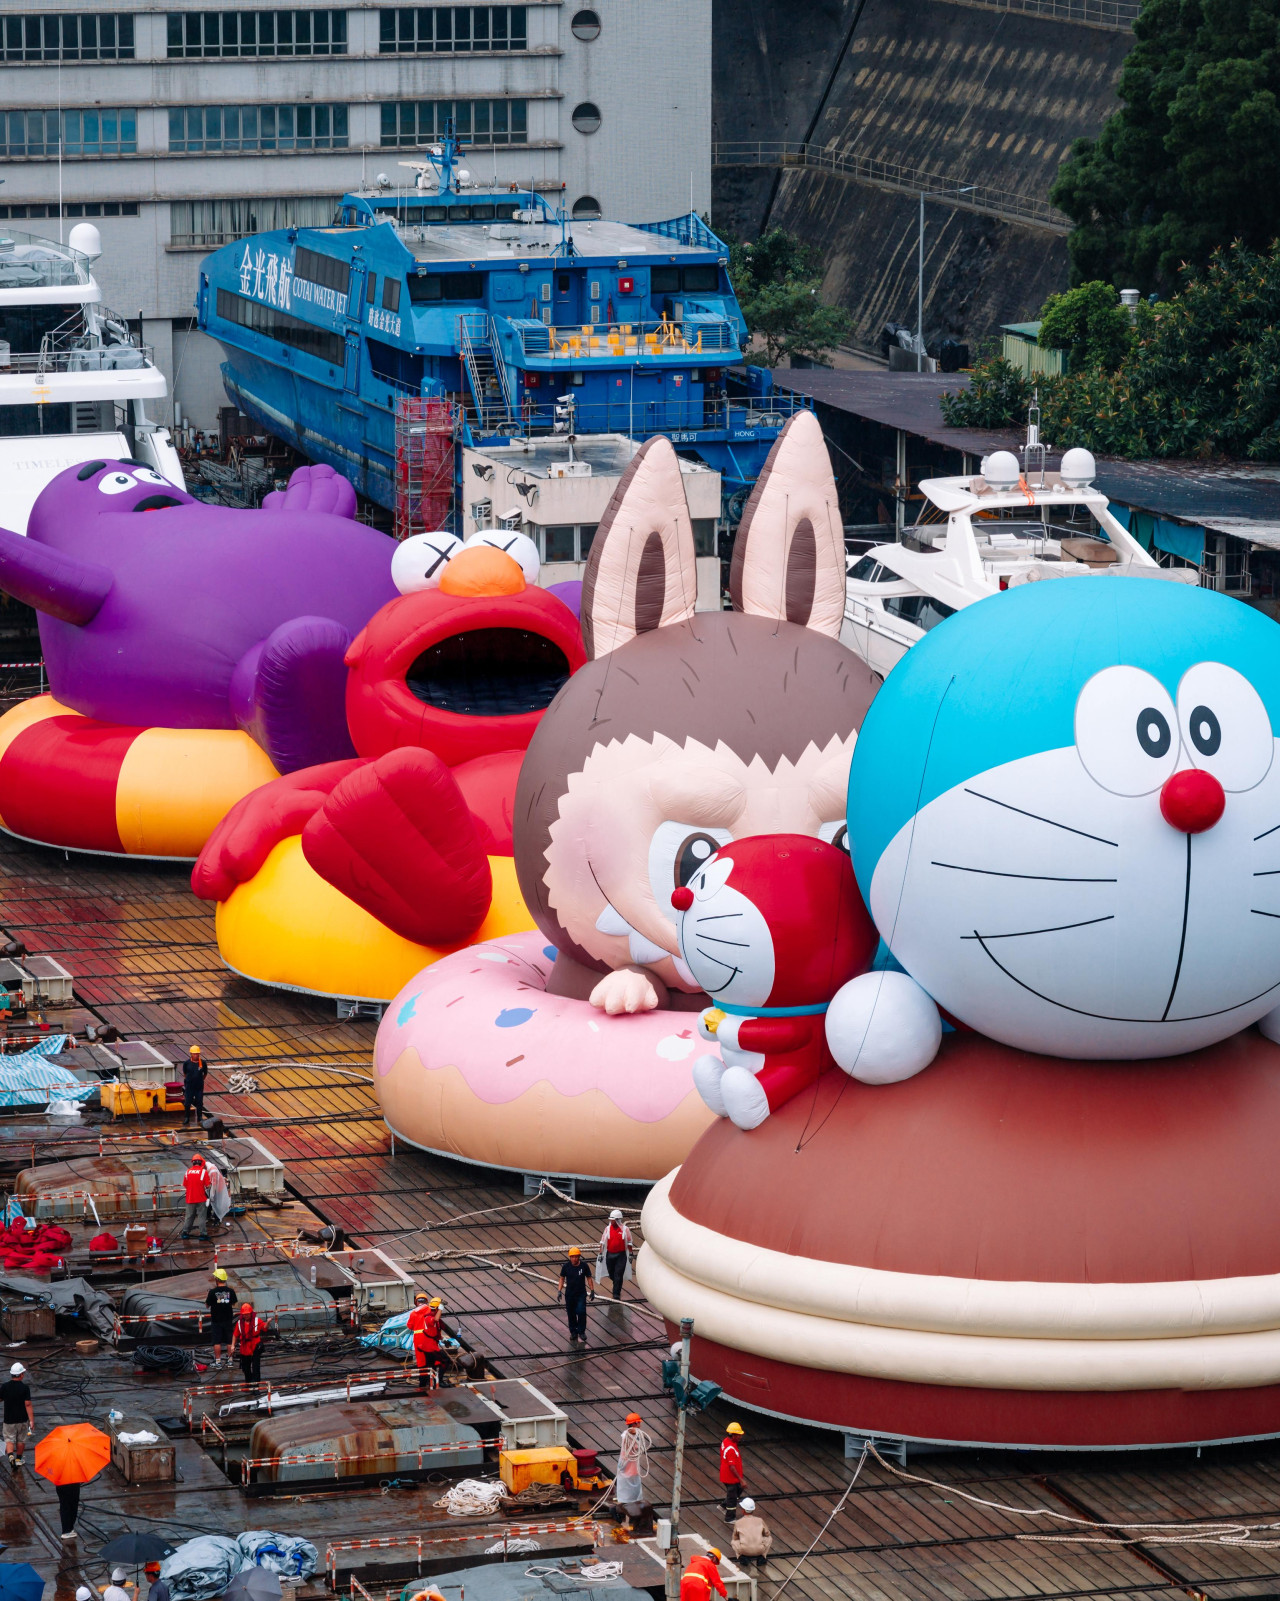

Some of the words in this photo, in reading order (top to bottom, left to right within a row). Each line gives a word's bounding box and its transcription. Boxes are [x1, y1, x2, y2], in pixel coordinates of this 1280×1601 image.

[239, 243, 293, 310] 金光飛航
[293, 277, 313, 302] COTAI
[314, 282, 336, 311] WATER
[336, 292, 348, 317] JET
[735, 430, 755, 438] HONG
